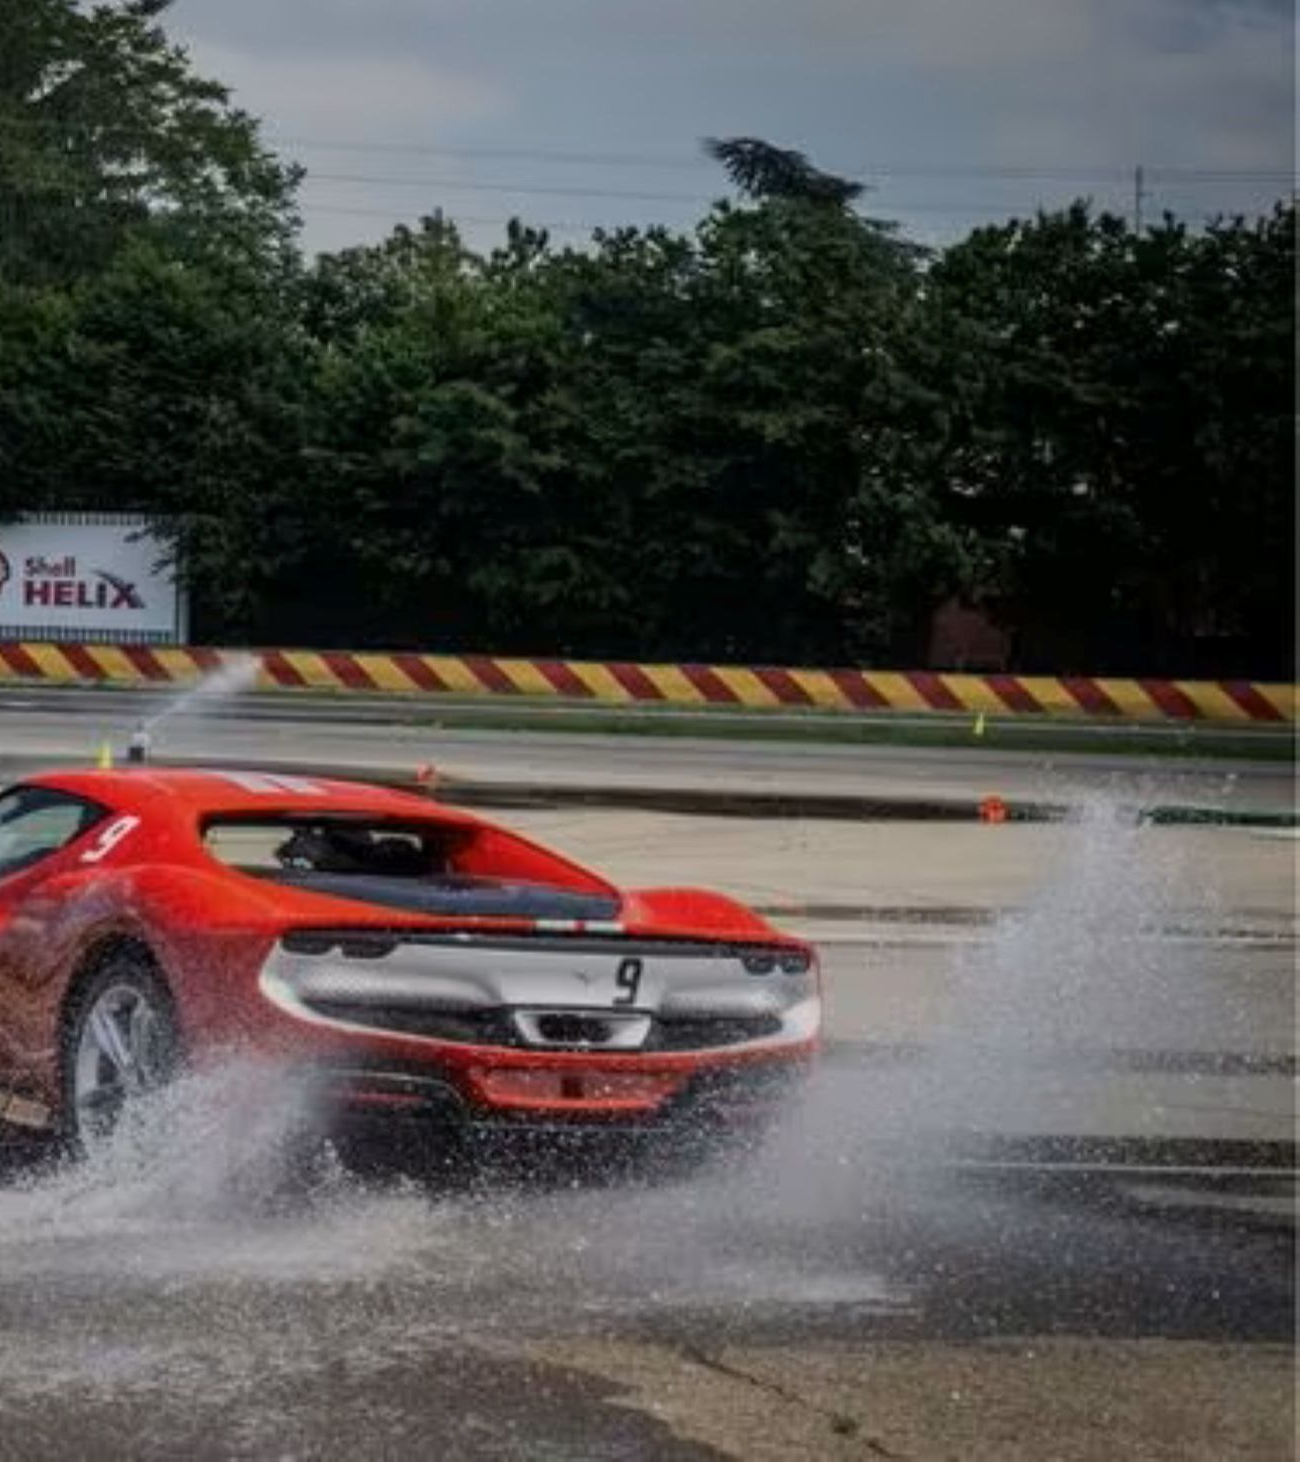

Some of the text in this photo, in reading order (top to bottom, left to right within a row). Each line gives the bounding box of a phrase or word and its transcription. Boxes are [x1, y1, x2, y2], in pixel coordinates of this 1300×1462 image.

[25, 556, 76, 577] Shell
[24, 577, 145, 609] HELIX
[80, 816, 141, 862] 9
[612, 957, 643, 1005] 9
